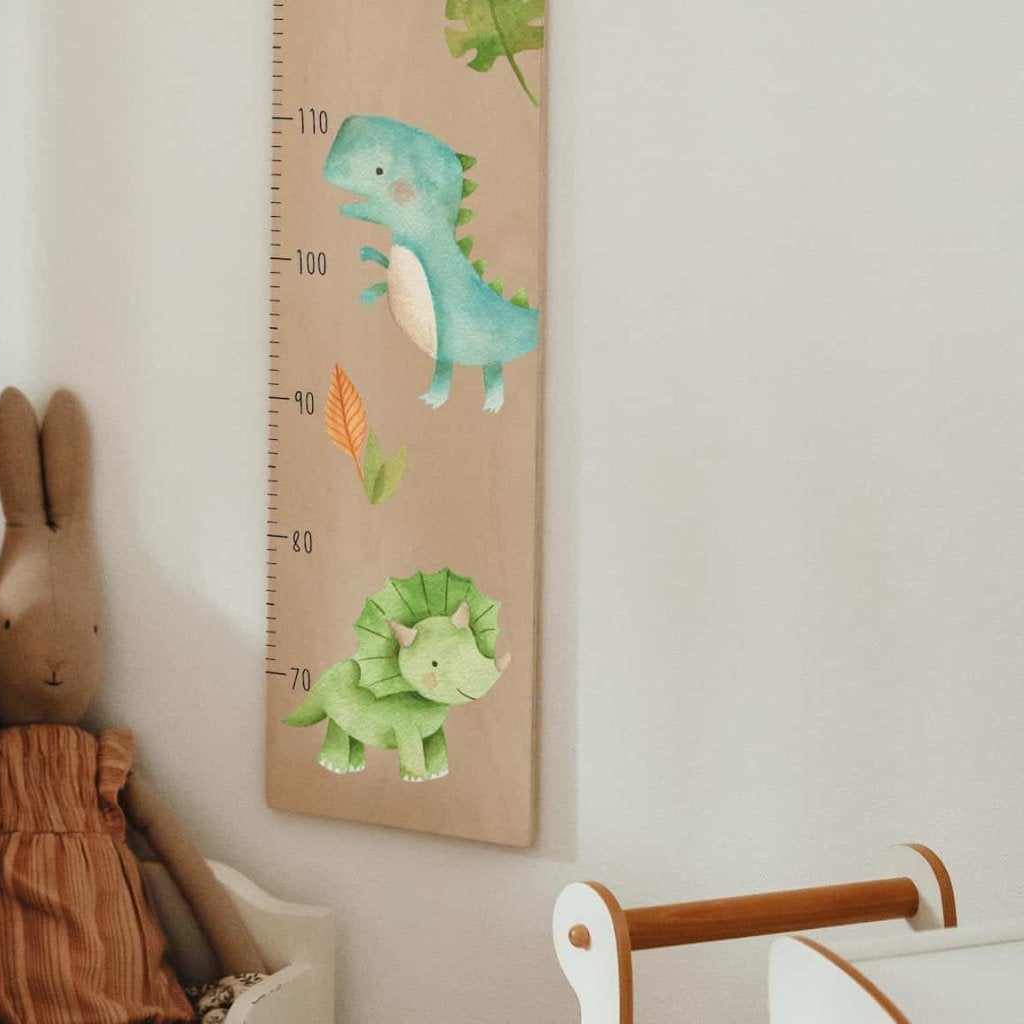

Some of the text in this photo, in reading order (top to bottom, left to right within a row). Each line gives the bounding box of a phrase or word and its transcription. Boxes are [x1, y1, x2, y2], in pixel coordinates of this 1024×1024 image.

[298, 107, 328, 135] 110
[296, 249, 327, 276] 100
[294, 390, 314, 416] 90
[292, 530, 313, 554] 80
[290, 667, 311, 692] 70
